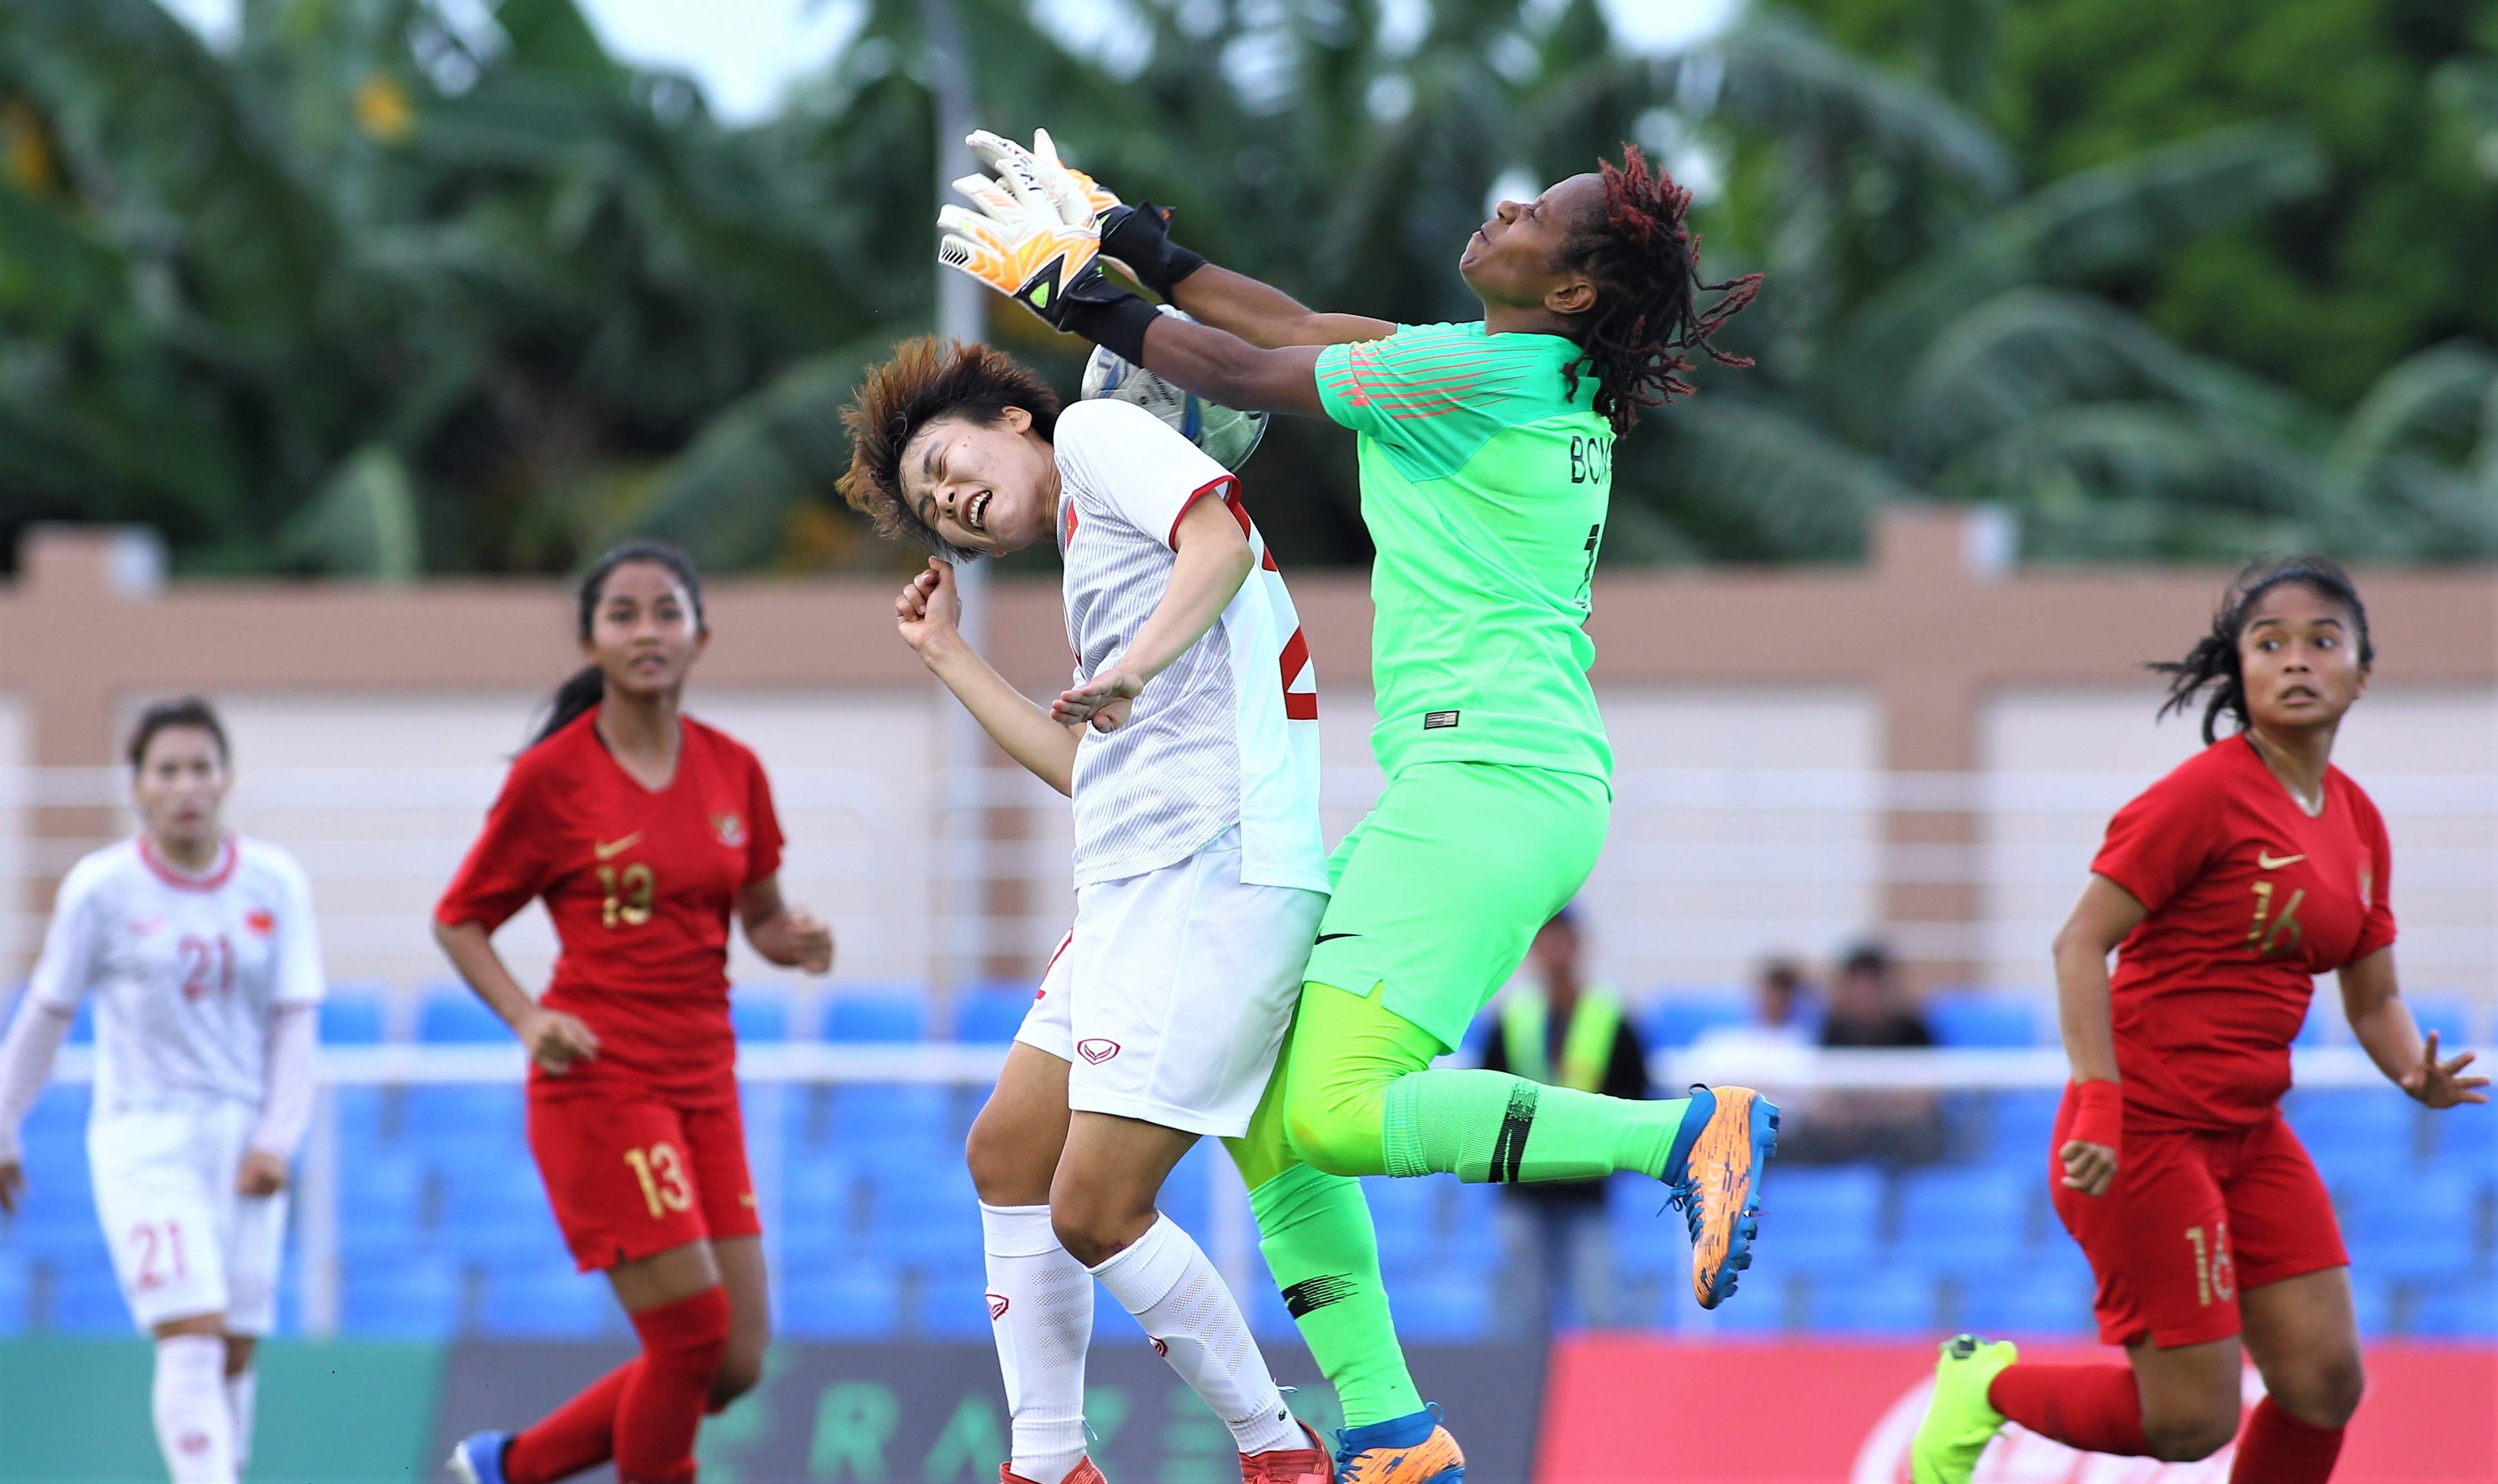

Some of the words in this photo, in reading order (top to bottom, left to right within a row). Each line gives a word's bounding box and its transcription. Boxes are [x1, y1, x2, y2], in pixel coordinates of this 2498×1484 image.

[595, 862, 654, 930] 13
[2244, 880, 2305, 952] 16
[178, 933, 235, 1002] 21
[623, 1142, 693, 1219] 13
[128, 1219, 187, 1289] 21
[2184, 1222, 2233, 1306] 16
